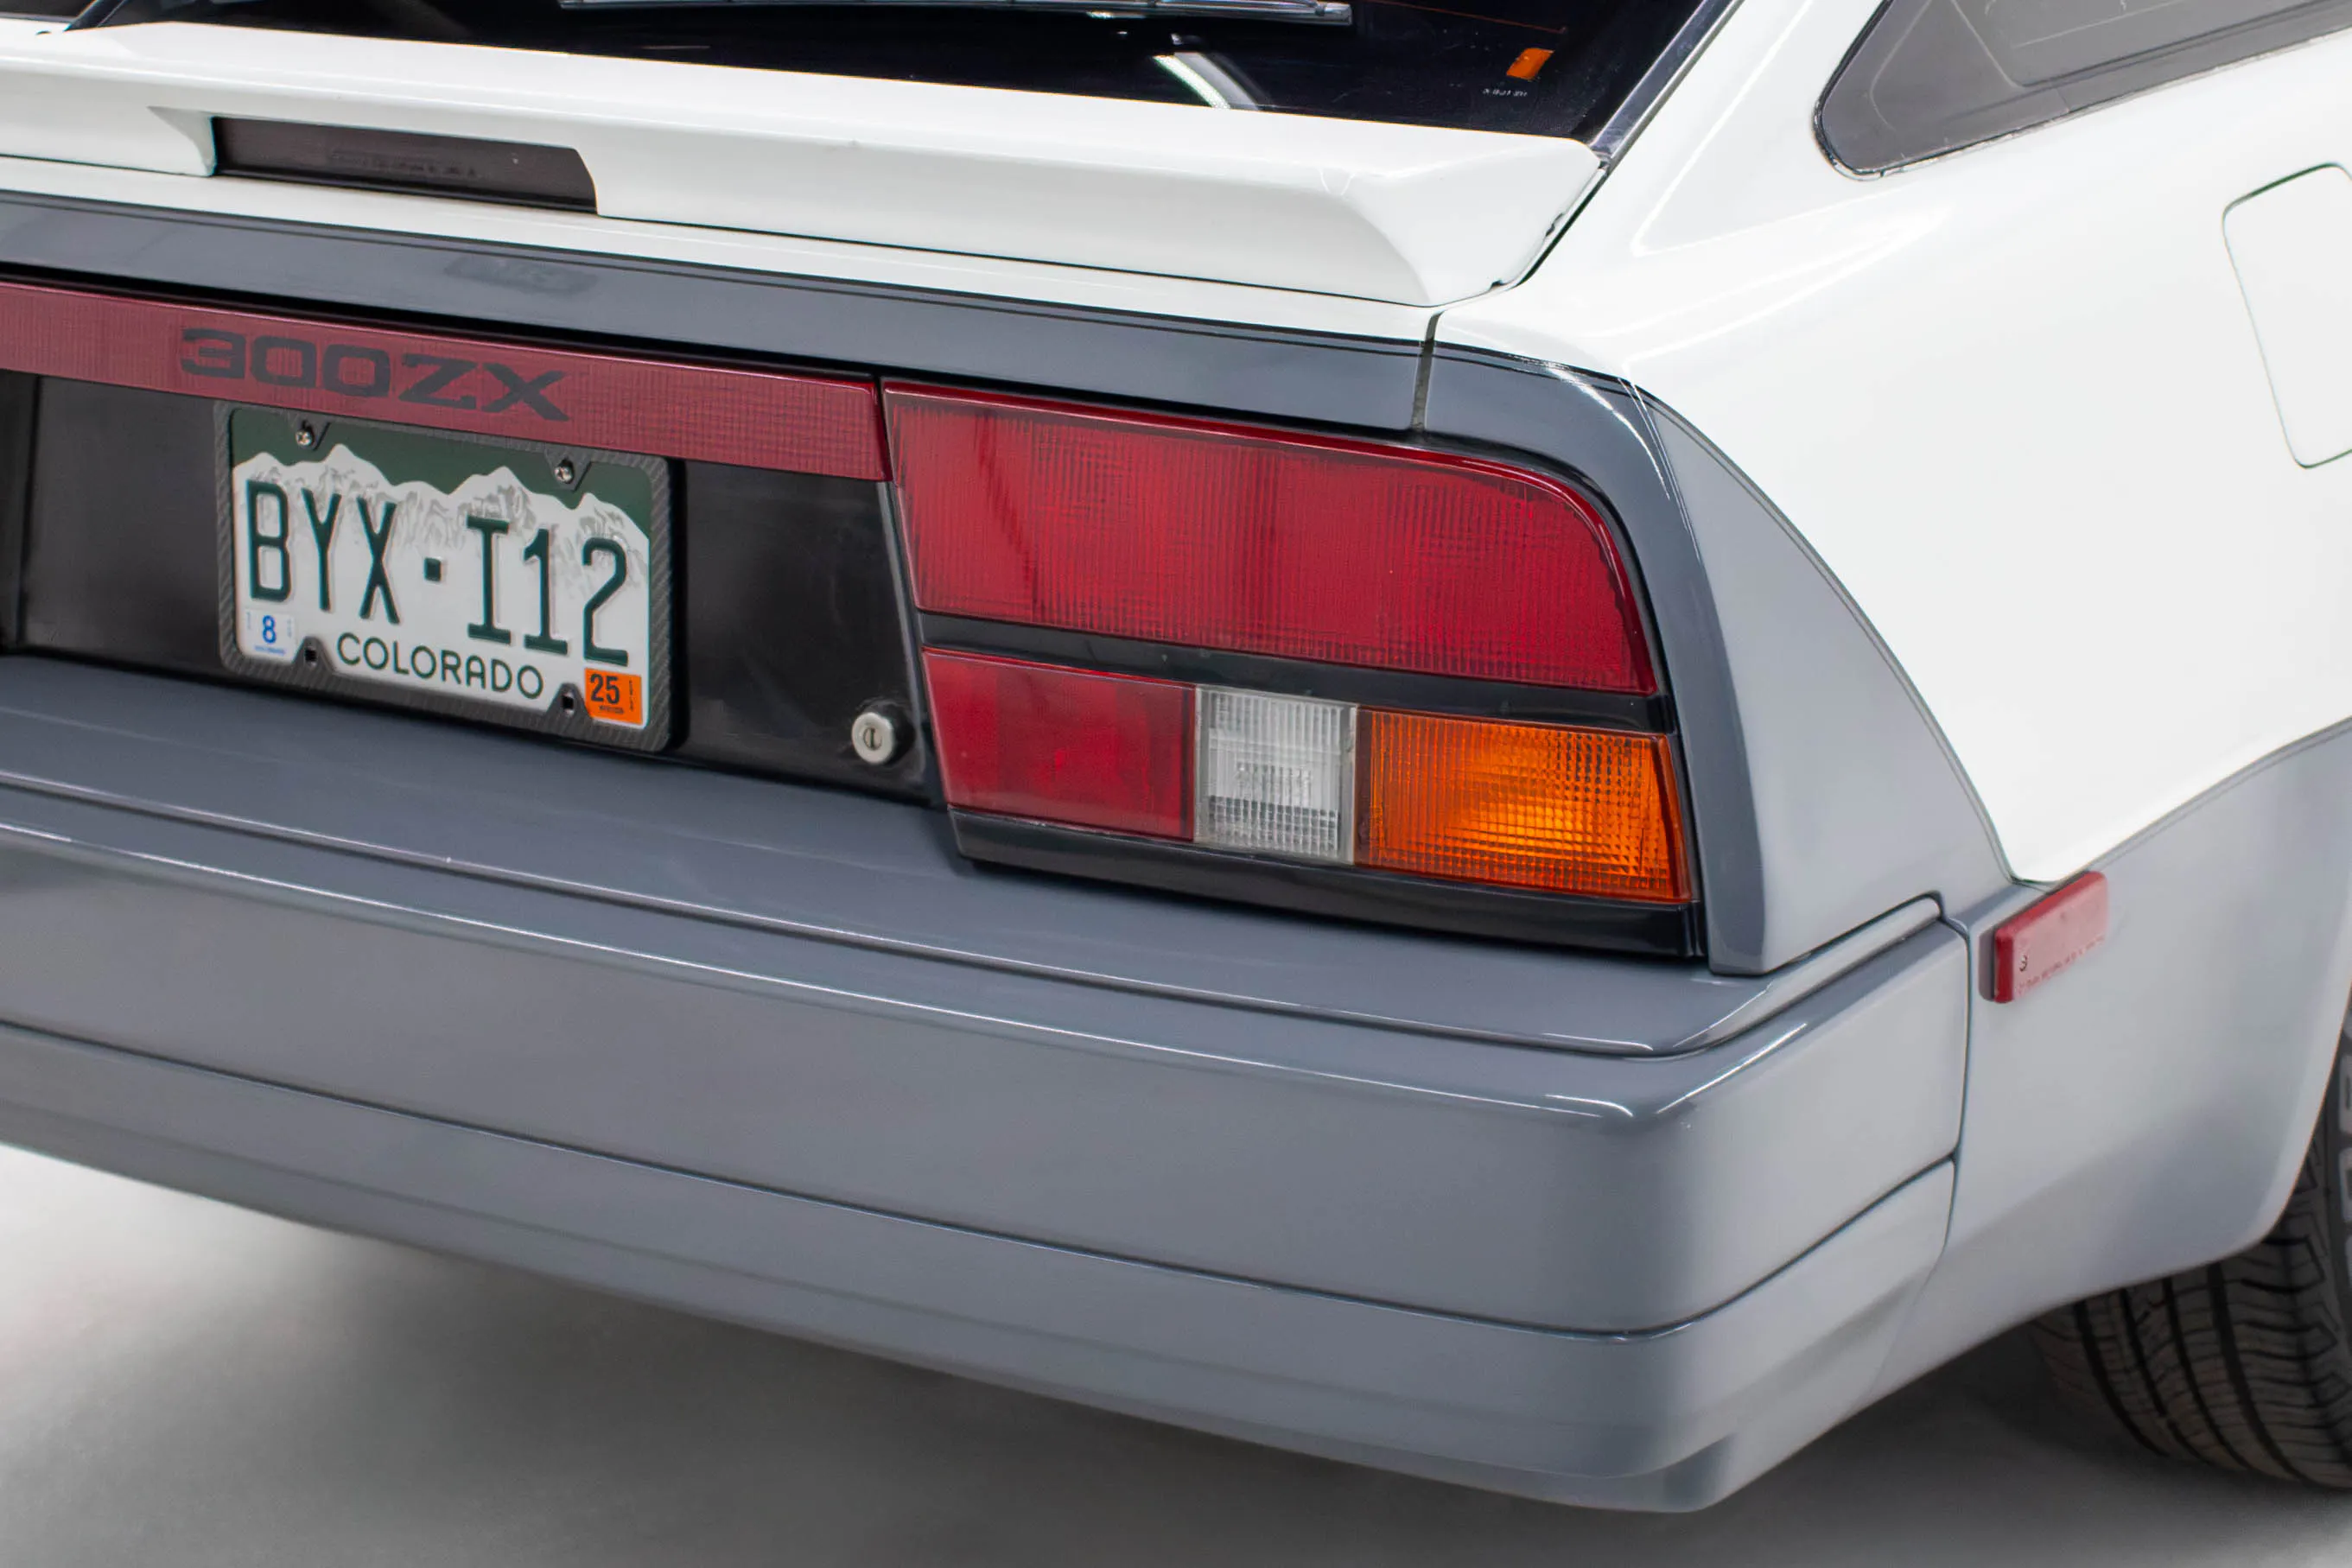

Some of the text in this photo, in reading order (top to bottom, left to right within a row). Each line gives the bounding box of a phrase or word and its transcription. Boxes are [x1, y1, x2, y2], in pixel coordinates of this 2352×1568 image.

[180, 327, 569, 422] 300ZX
[262, 614, 277, 644] 8
[336, 632, 544, 700] COLORADO
[589, 673, 620, 704] 25
